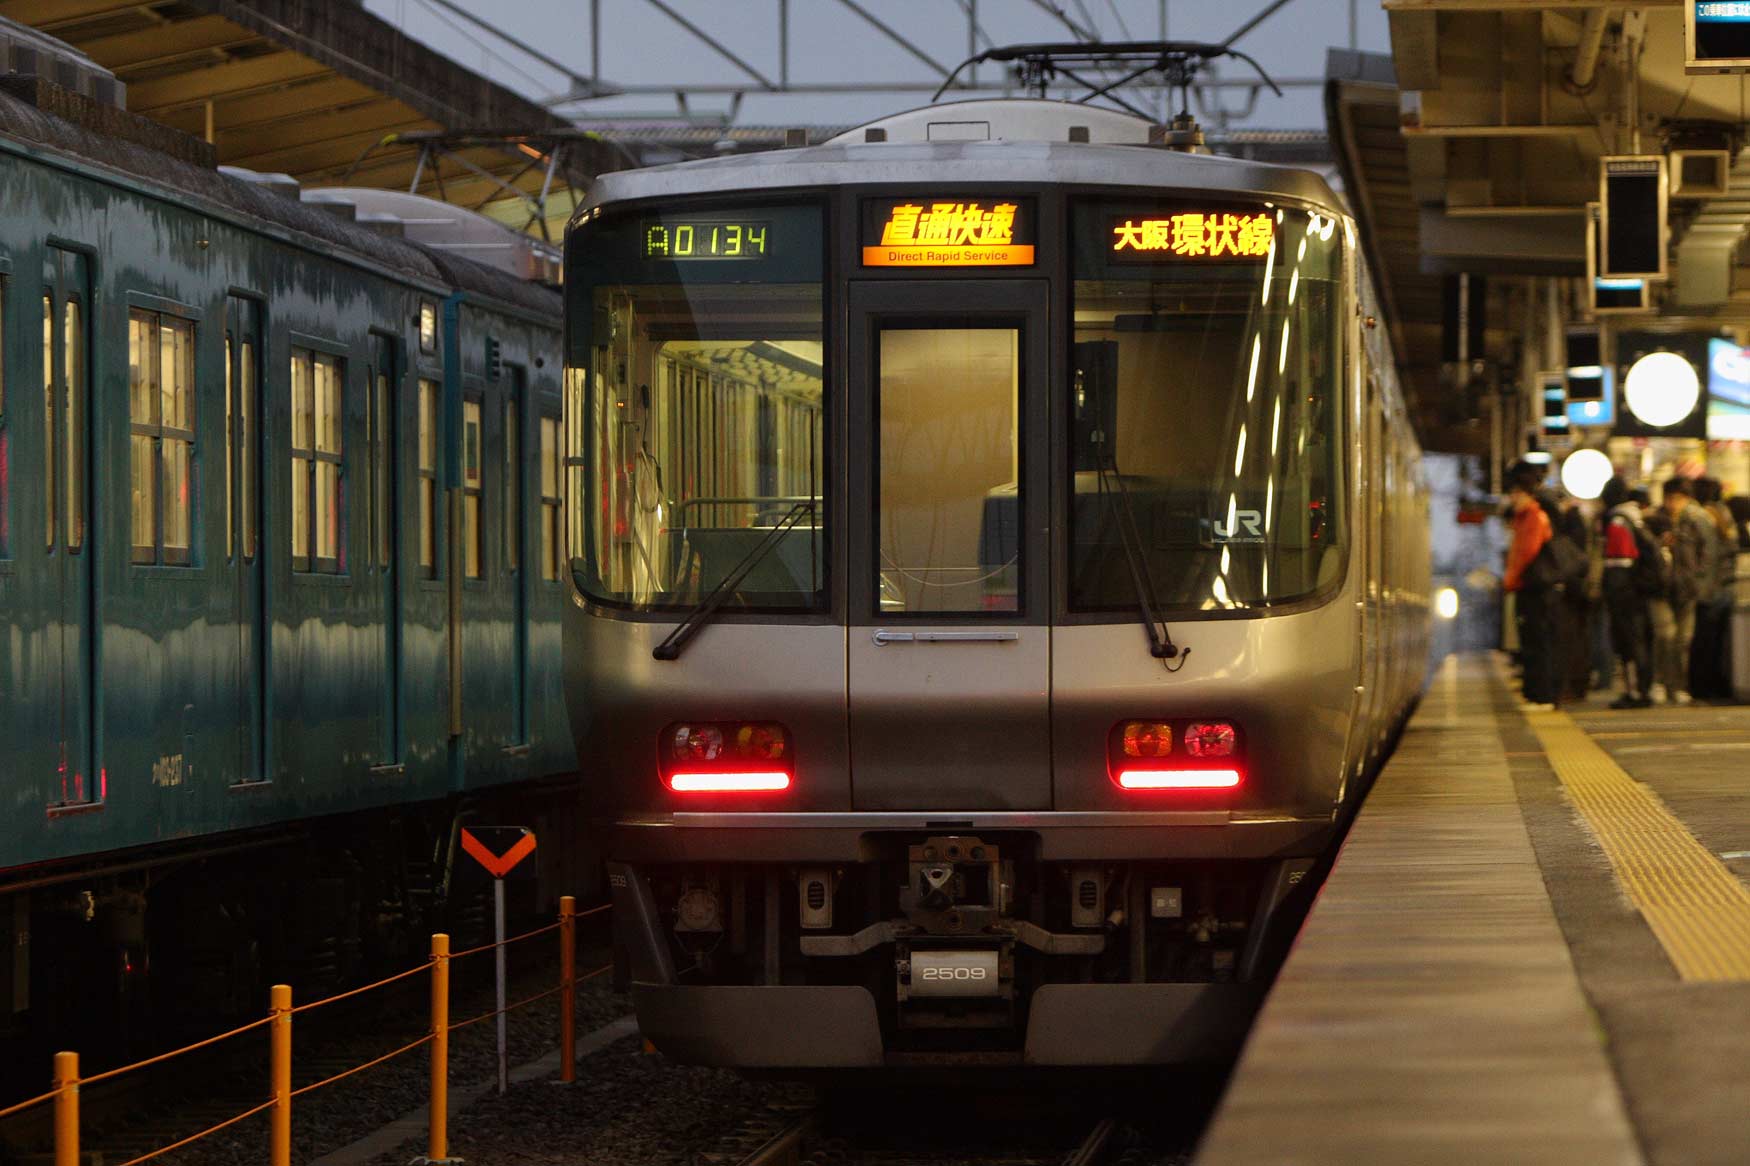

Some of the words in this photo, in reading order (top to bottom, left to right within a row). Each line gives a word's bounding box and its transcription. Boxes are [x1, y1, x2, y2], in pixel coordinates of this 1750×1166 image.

[880, 203, 1018, 246] 直通快速
[647, 225, 766, 256] A0134
[888, 251, 923, 262] Direct
[927, 251, 960, 263] Rapid
[964, 250, 1009, 261] Service
[1213, 509, 1261, 537] JR
[922, 967, 986, 980] 2509
